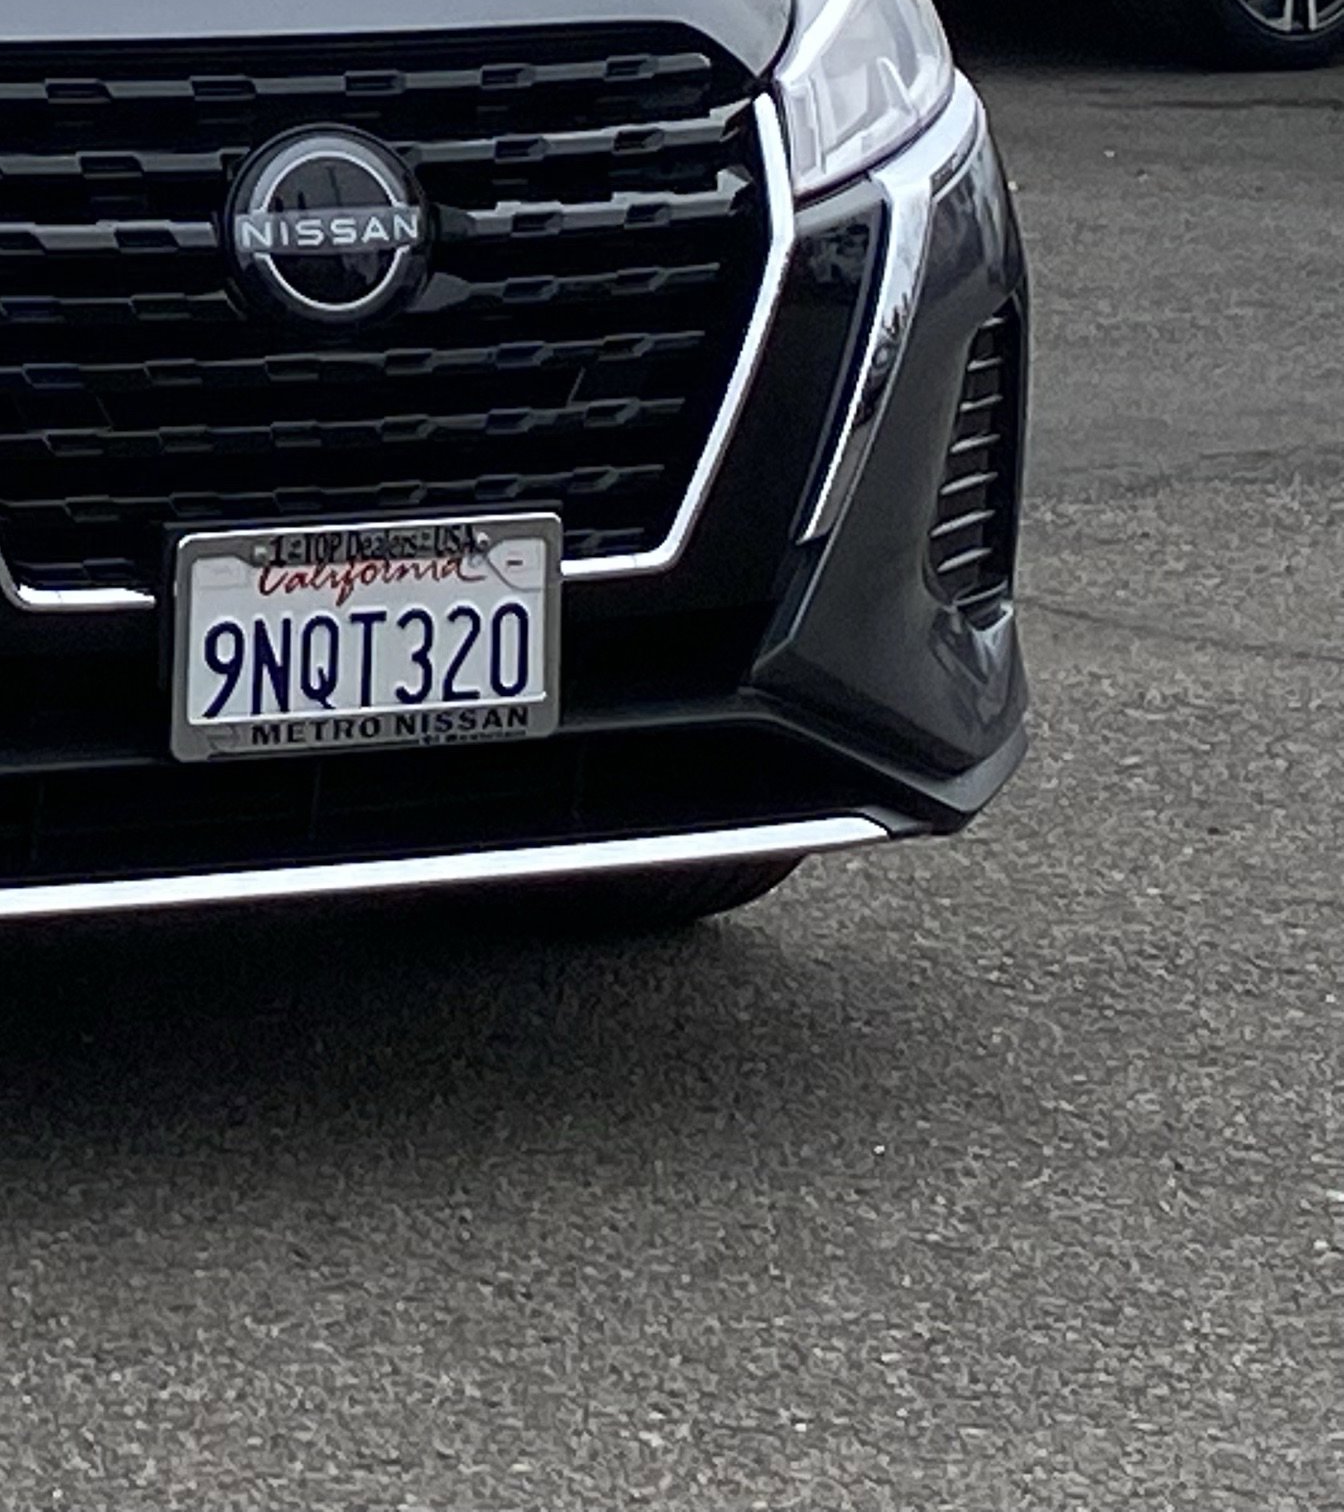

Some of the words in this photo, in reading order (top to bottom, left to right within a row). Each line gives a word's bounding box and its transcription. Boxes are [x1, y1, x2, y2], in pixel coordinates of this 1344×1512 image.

[240, 214, 418, 247] NISSAN
[259, 550, 486, 607] California
[203, 601, 530, 719] 9NQT320
[250, 716, 381, 745] METRO
[394, 707, 529, 736] NISSAN
